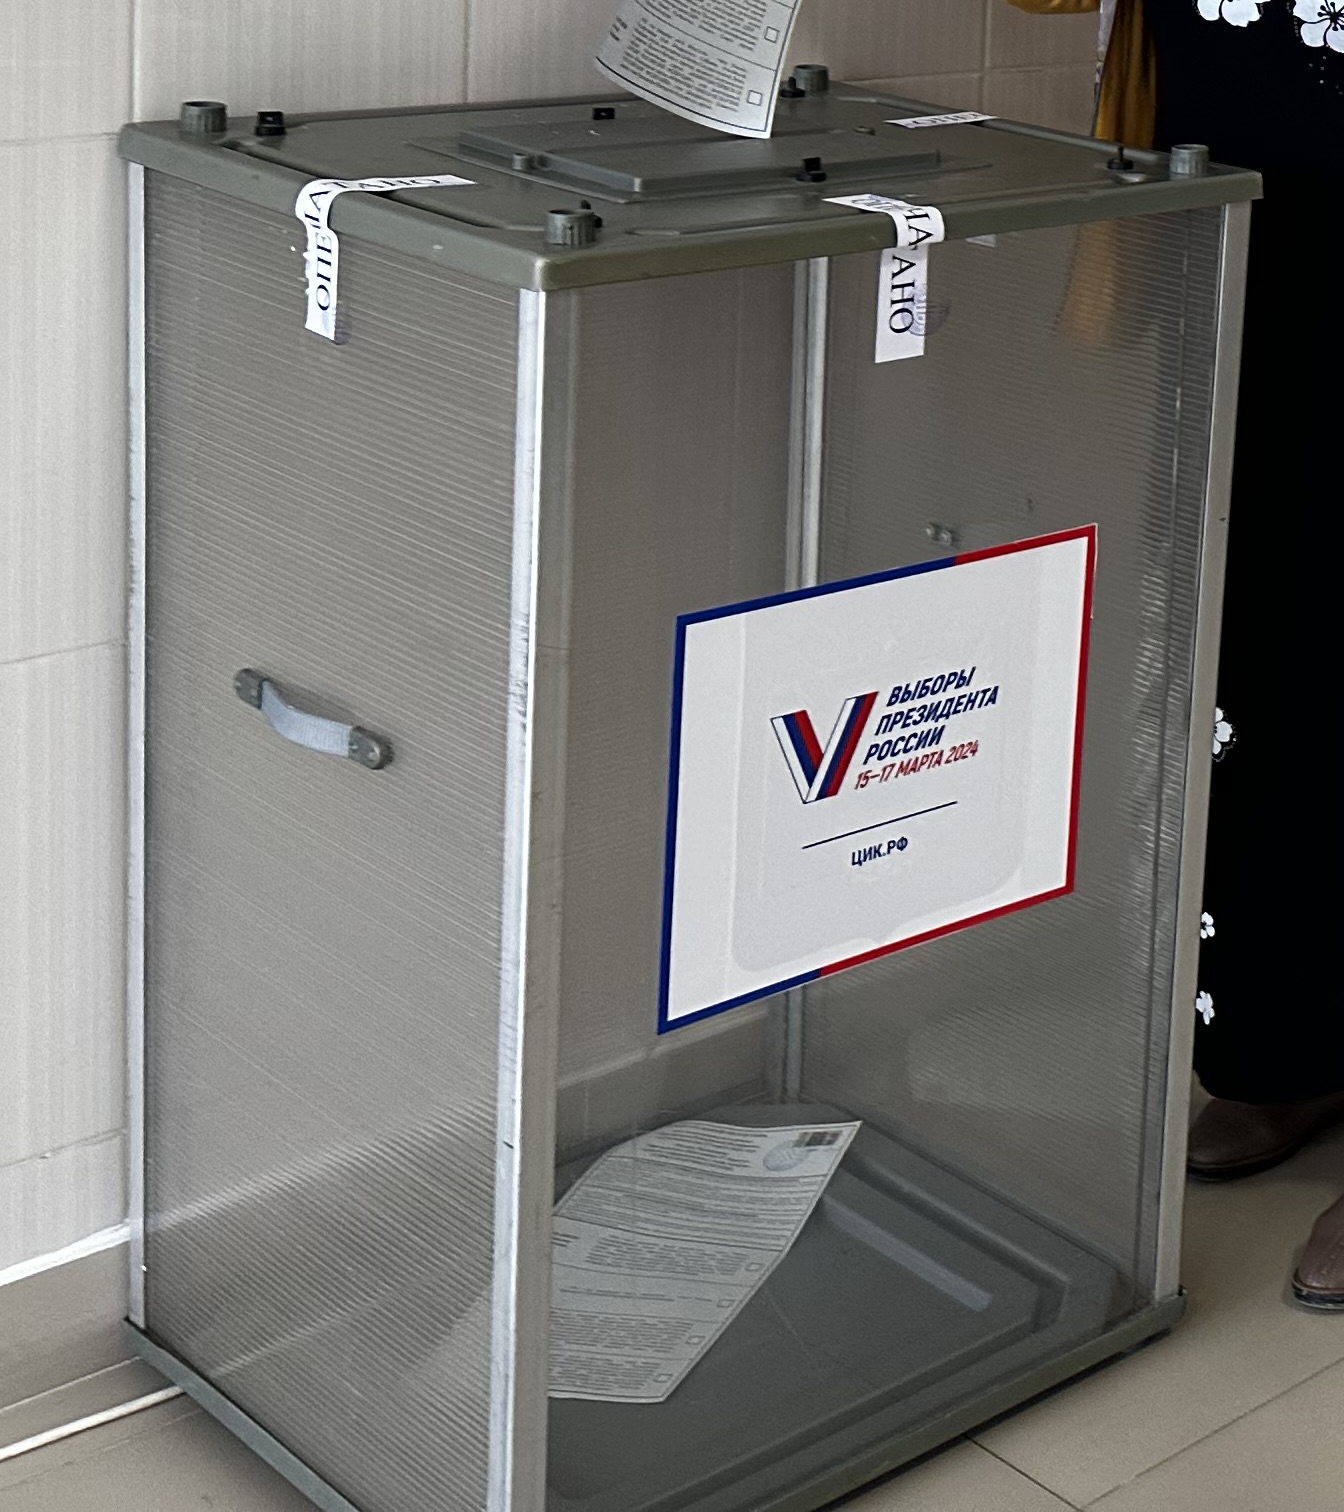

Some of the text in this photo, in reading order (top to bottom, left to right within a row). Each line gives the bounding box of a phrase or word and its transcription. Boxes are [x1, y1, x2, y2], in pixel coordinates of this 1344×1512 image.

[886, 666, 977, 707] ВЫБОРЫ
[874, 685, 1000, 736] ПРЕЗИДЕНТА
[863, 725, 946, 765] РОССИИ
[894, 750, 944, 779] МАРТА
[944, 740, 979, 765] 2024
[851, 836, 909, 866] ЦИК.РФ
